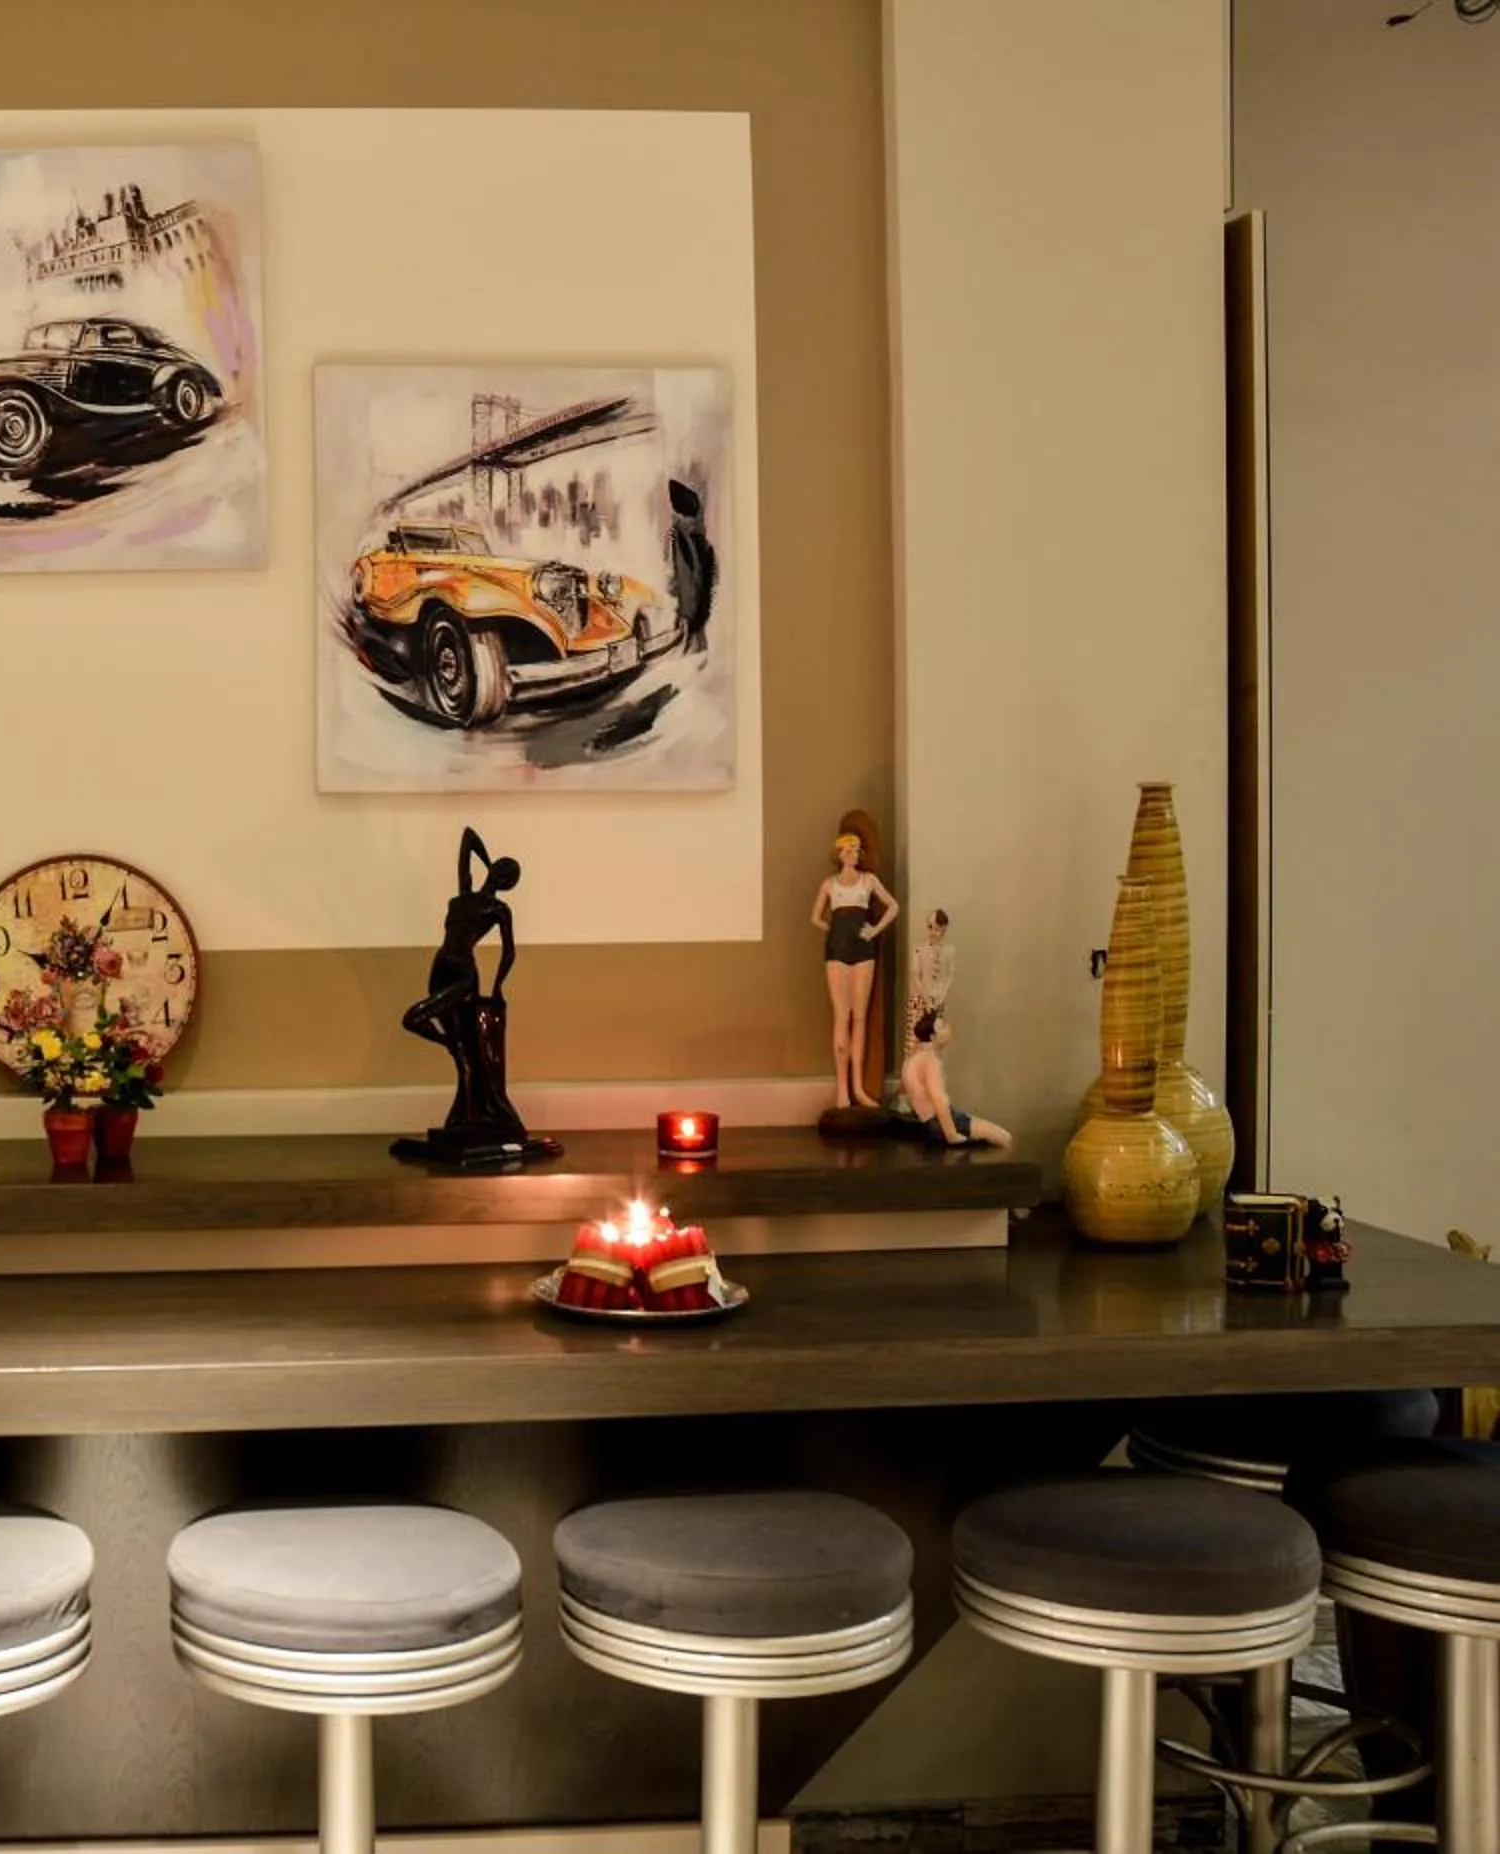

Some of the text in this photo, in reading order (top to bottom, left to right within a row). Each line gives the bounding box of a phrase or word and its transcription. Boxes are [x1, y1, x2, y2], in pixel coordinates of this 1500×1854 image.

[60, 868, 88, 901] 12
[13, 888, 32, 918] 11
[150, 998, 176, 1028] 4
